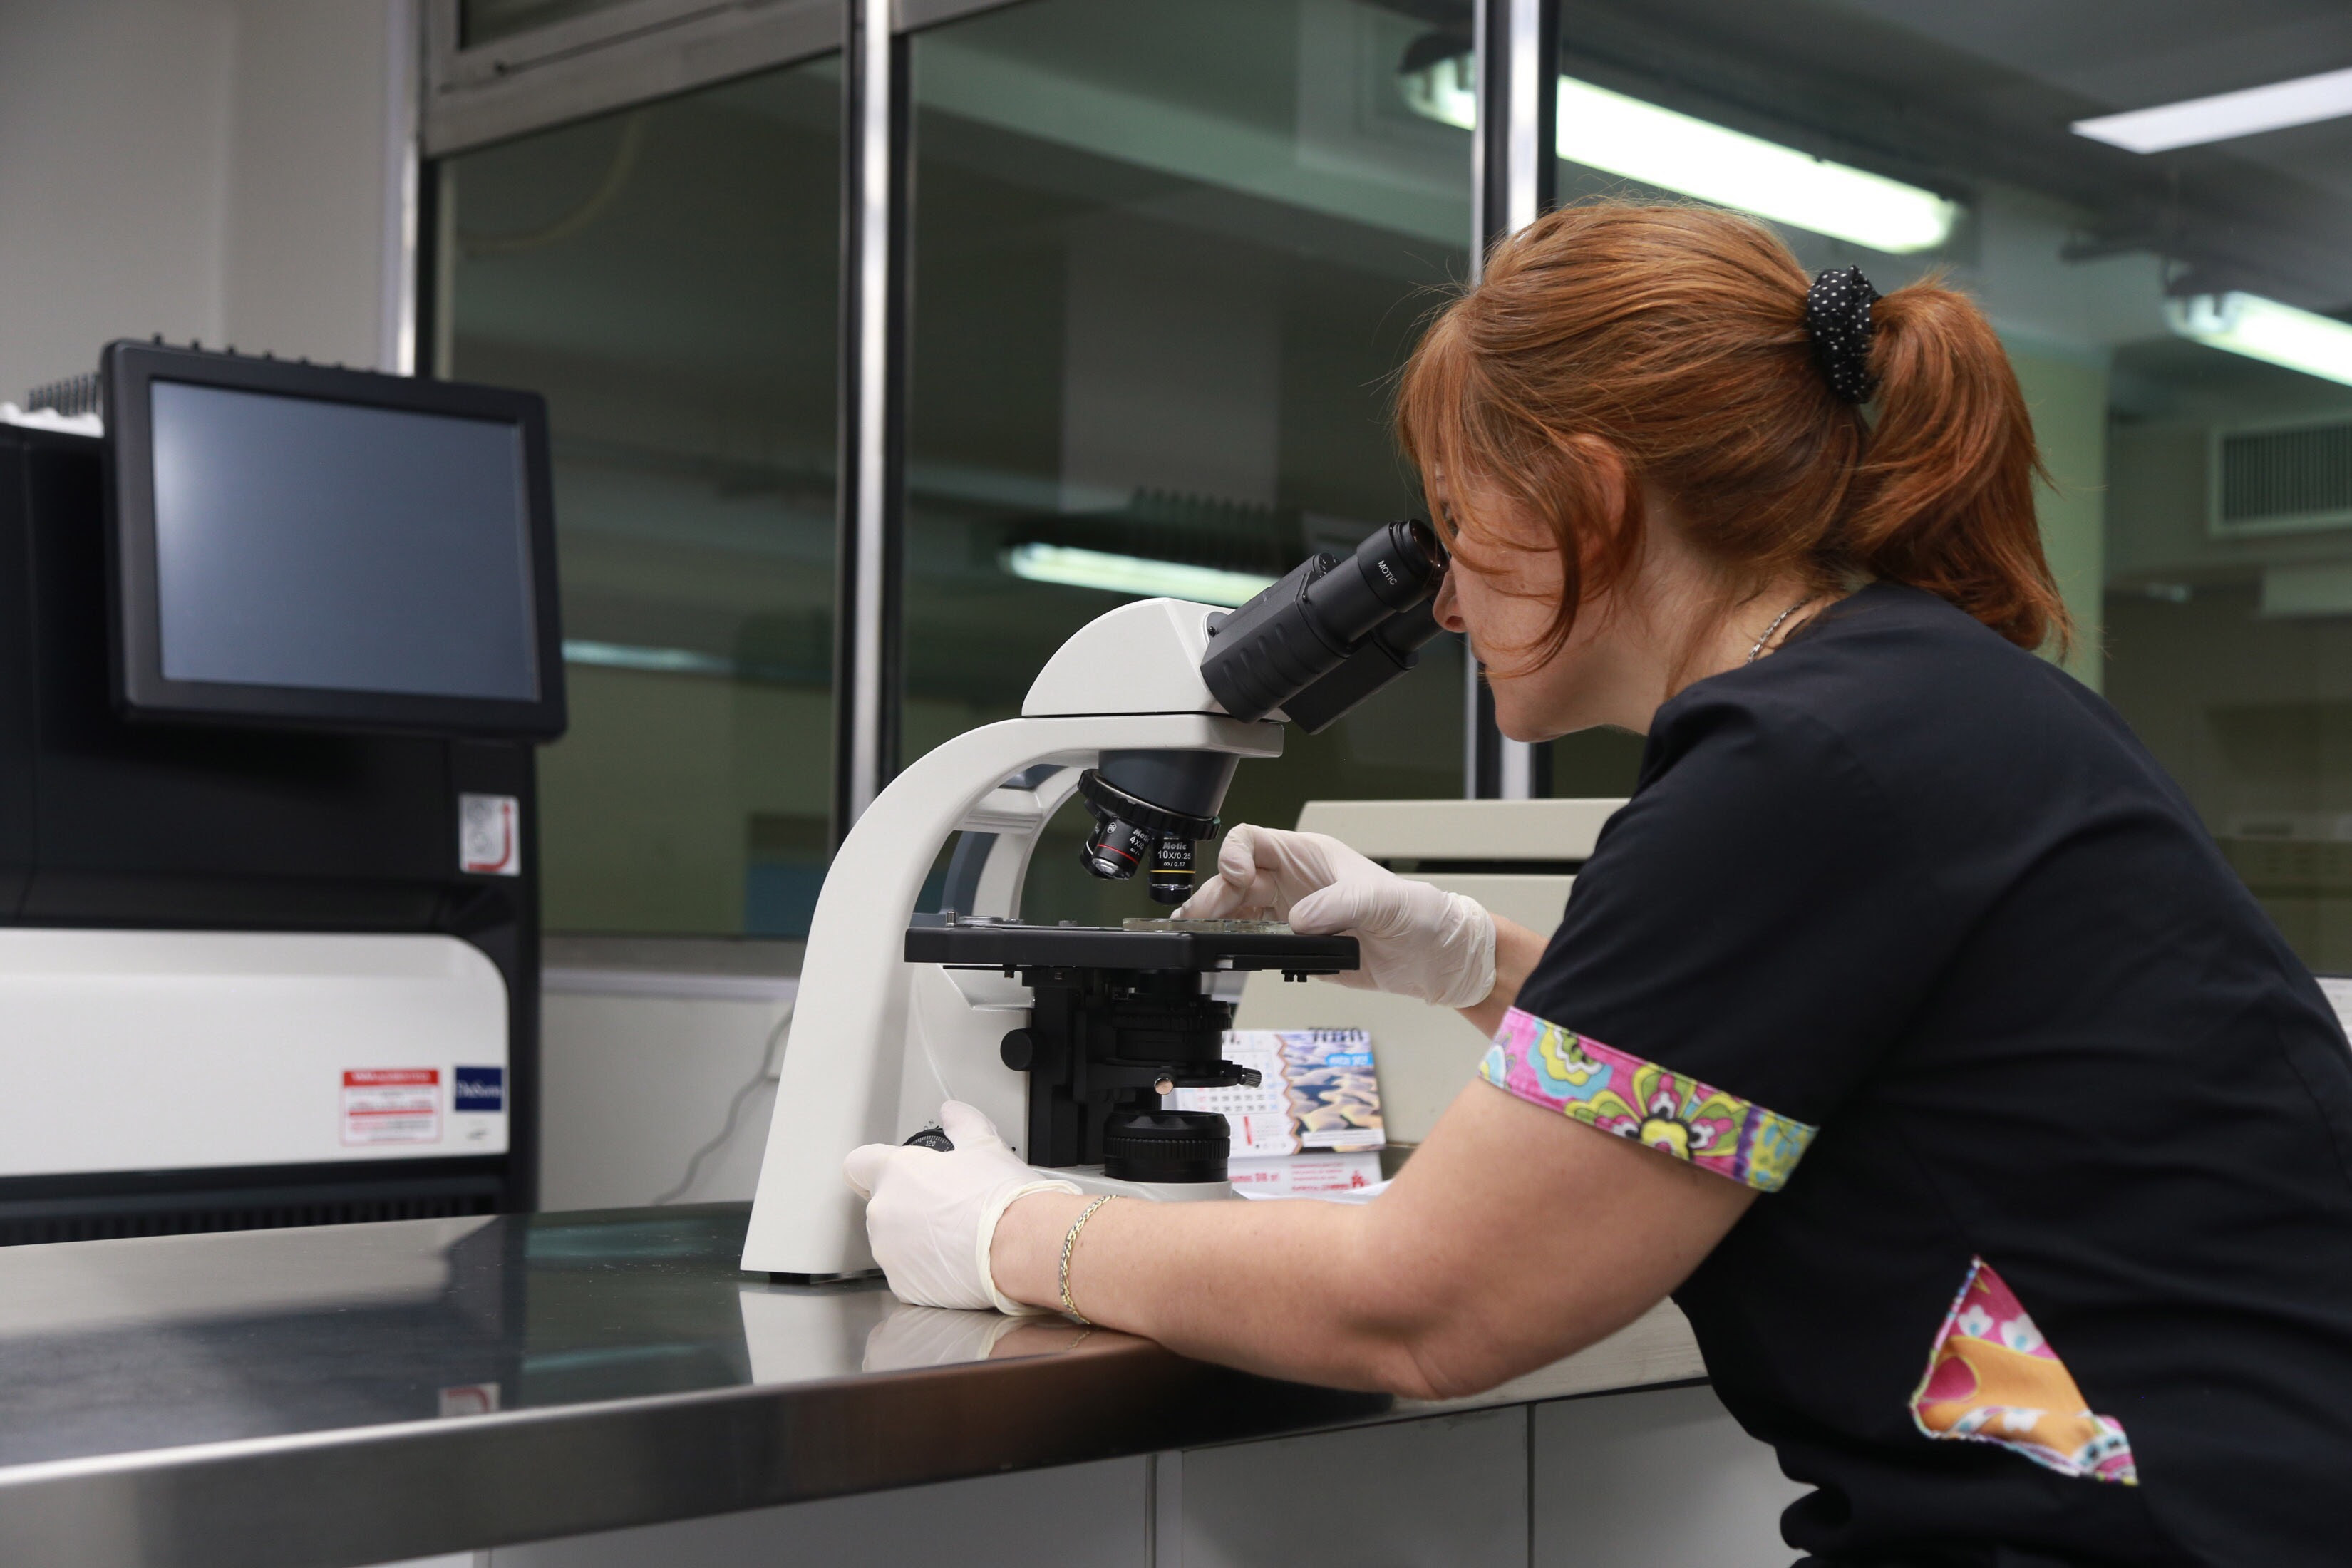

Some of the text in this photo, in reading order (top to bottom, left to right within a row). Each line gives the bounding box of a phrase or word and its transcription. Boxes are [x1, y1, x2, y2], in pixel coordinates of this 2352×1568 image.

[1377, 559, 1397, 585] MOTIC
[1162, 842, 1187, 850] Motic
[1157, 850, 1192, 860] 10X/0.25
